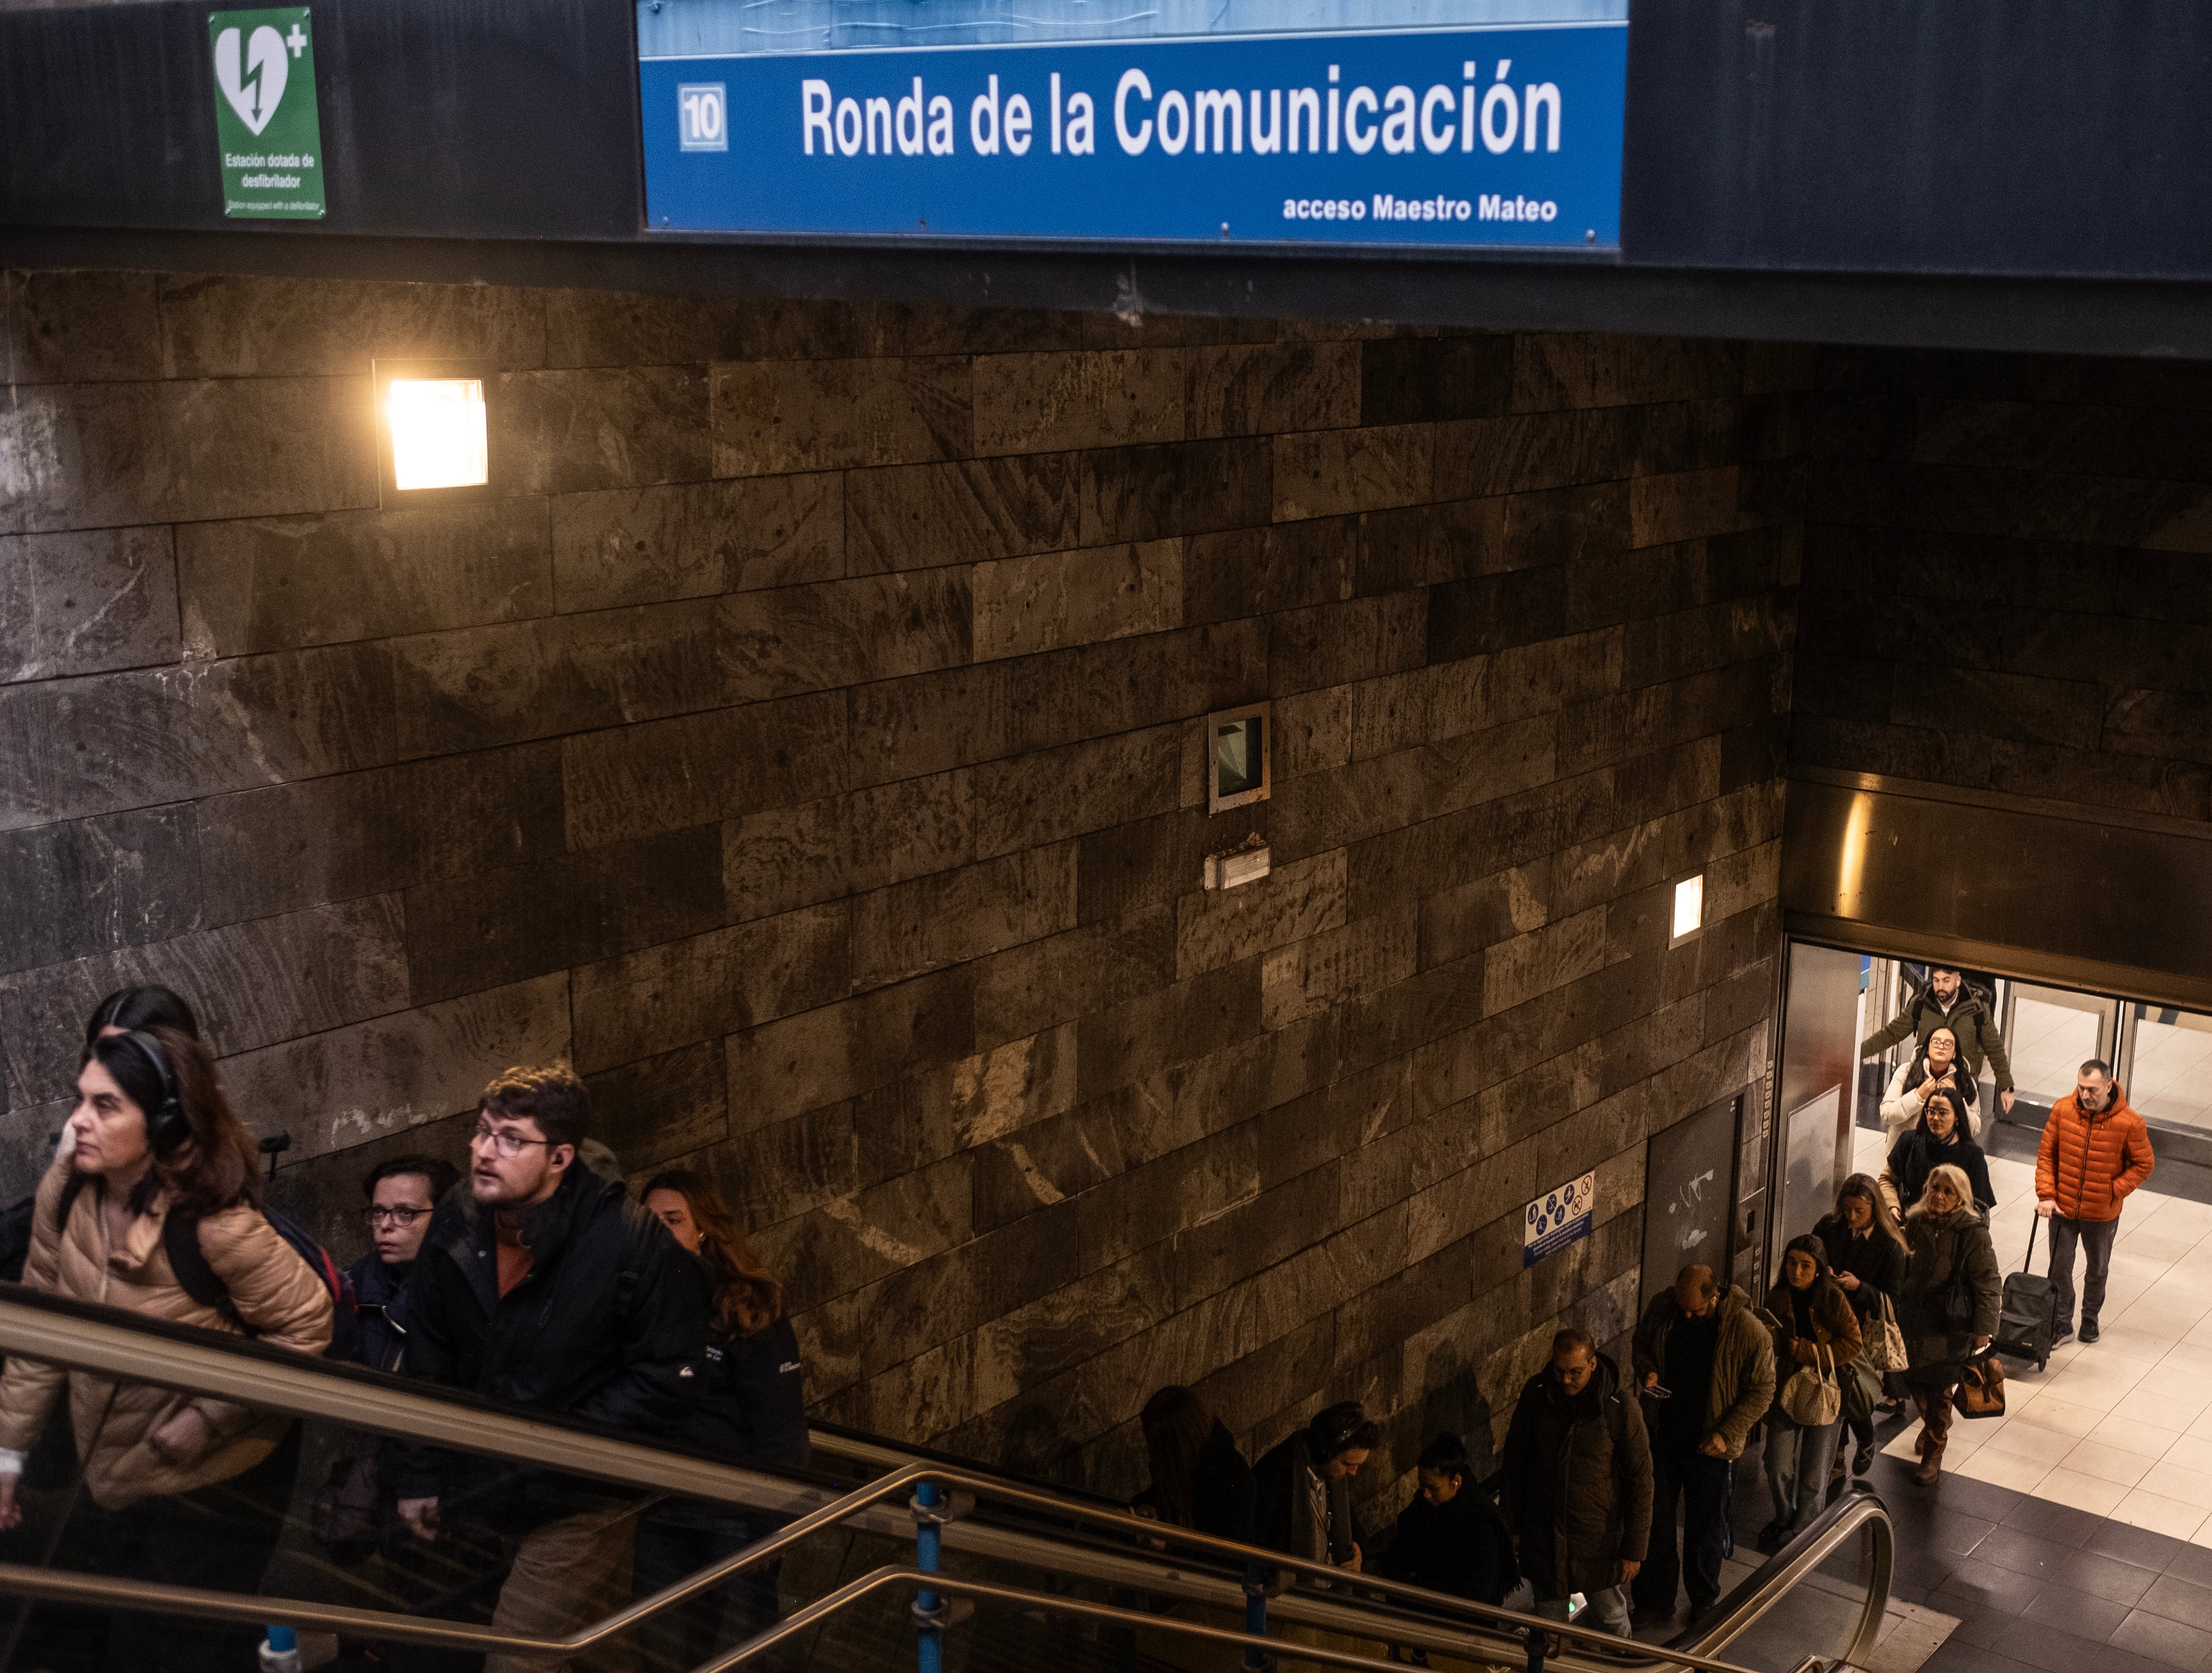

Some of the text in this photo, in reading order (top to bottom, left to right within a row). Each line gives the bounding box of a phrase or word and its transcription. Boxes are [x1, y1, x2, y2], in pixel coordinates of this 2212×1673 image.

[684, 93, 721, 138] 10
[802, 59, 1561, 156] Ronda de la Comunicación
[226, 153, 315, 167] Estación dotada de
[242, 174, 301, 188] desfibrilador
[1283, 195, 1557, 222] acceso Maestro Mateo
